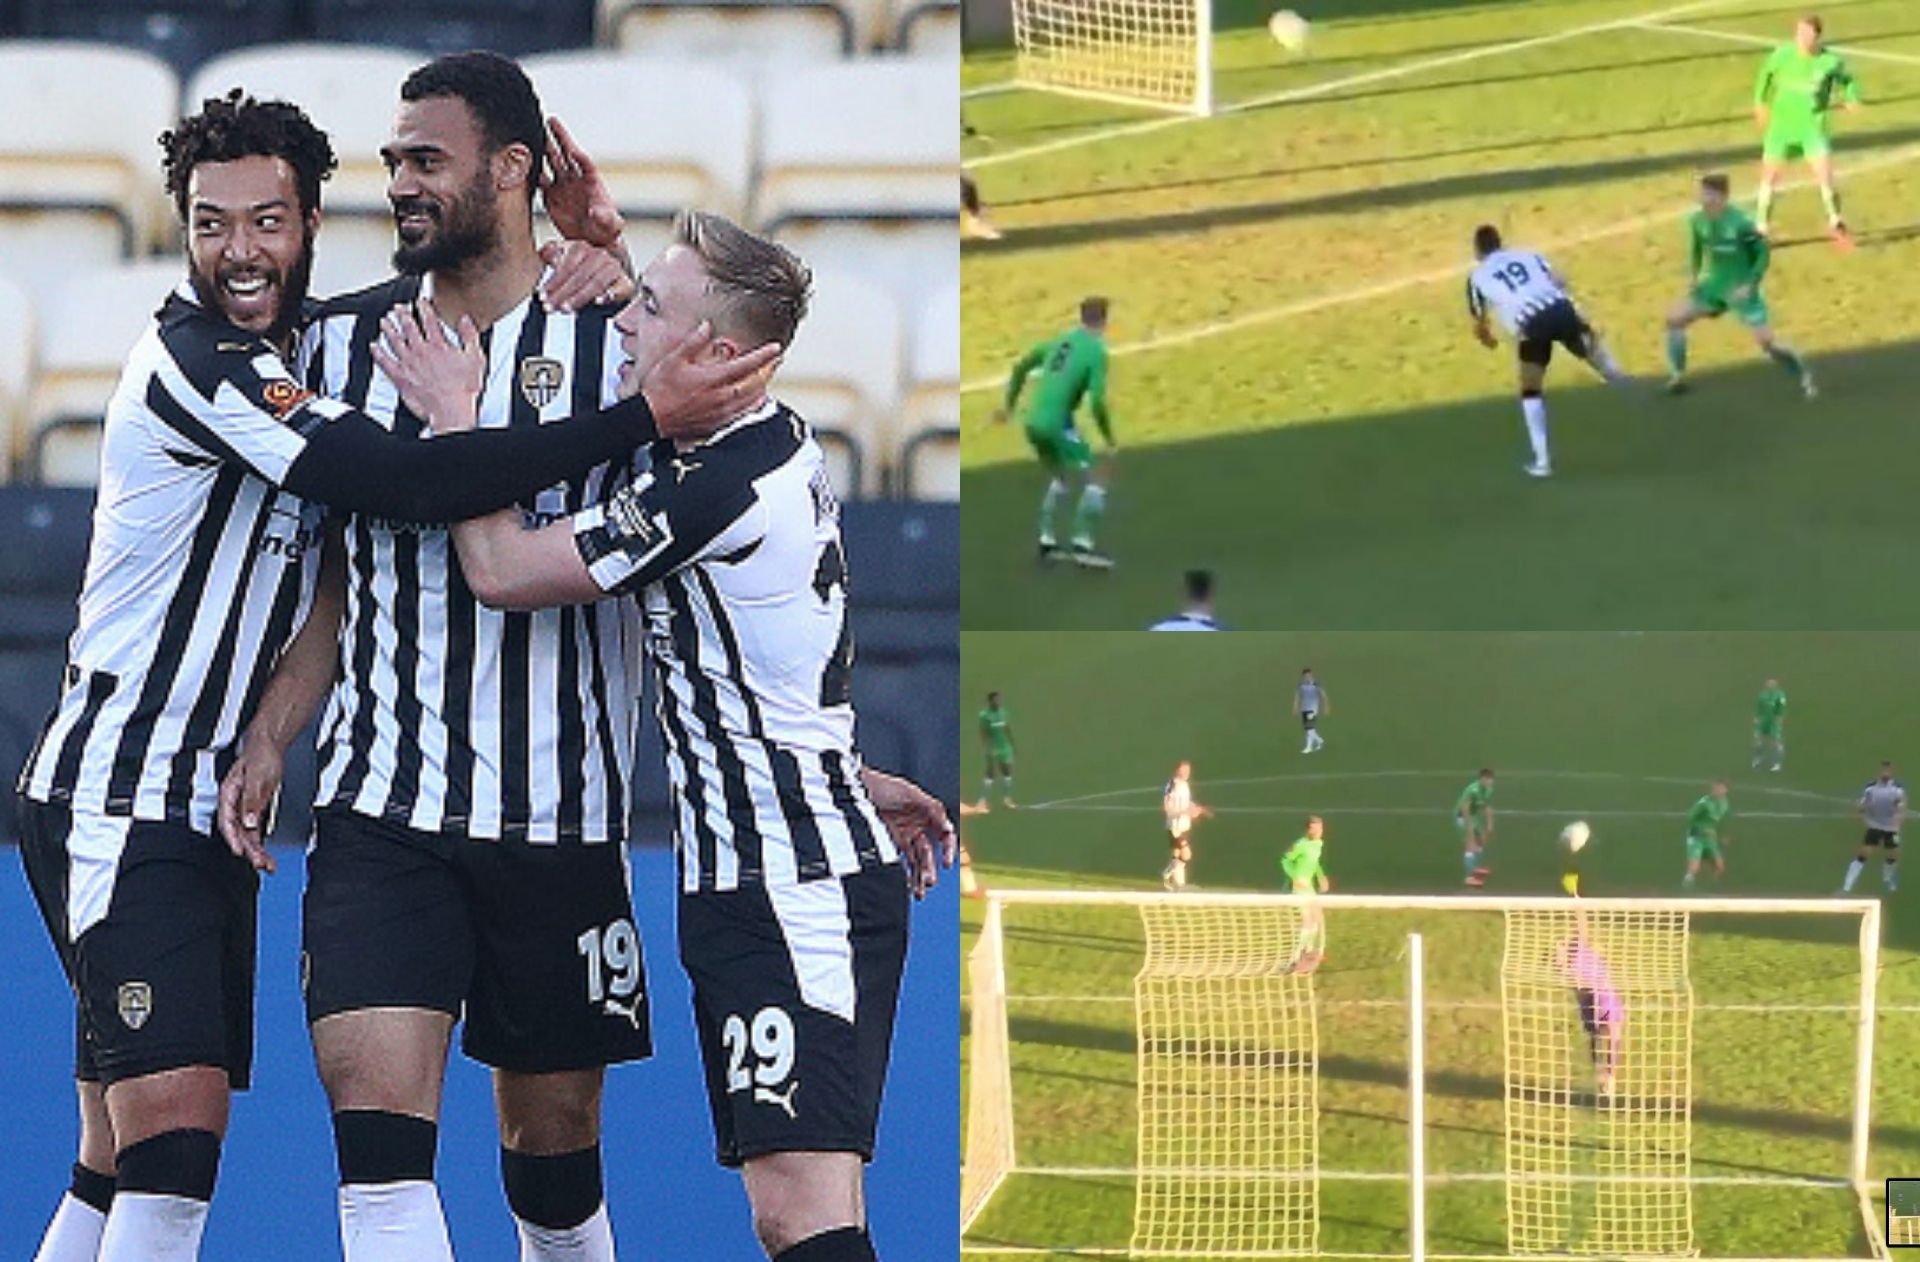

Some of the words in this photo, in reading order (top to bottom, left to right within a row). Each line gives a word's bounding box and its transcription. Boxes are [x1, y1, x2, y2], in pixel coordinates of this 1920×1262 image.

[1493, 262, 1531, 293] 19
[577, 918, 640, 1002] 19
[722, 1006, 796, 1093] 29
